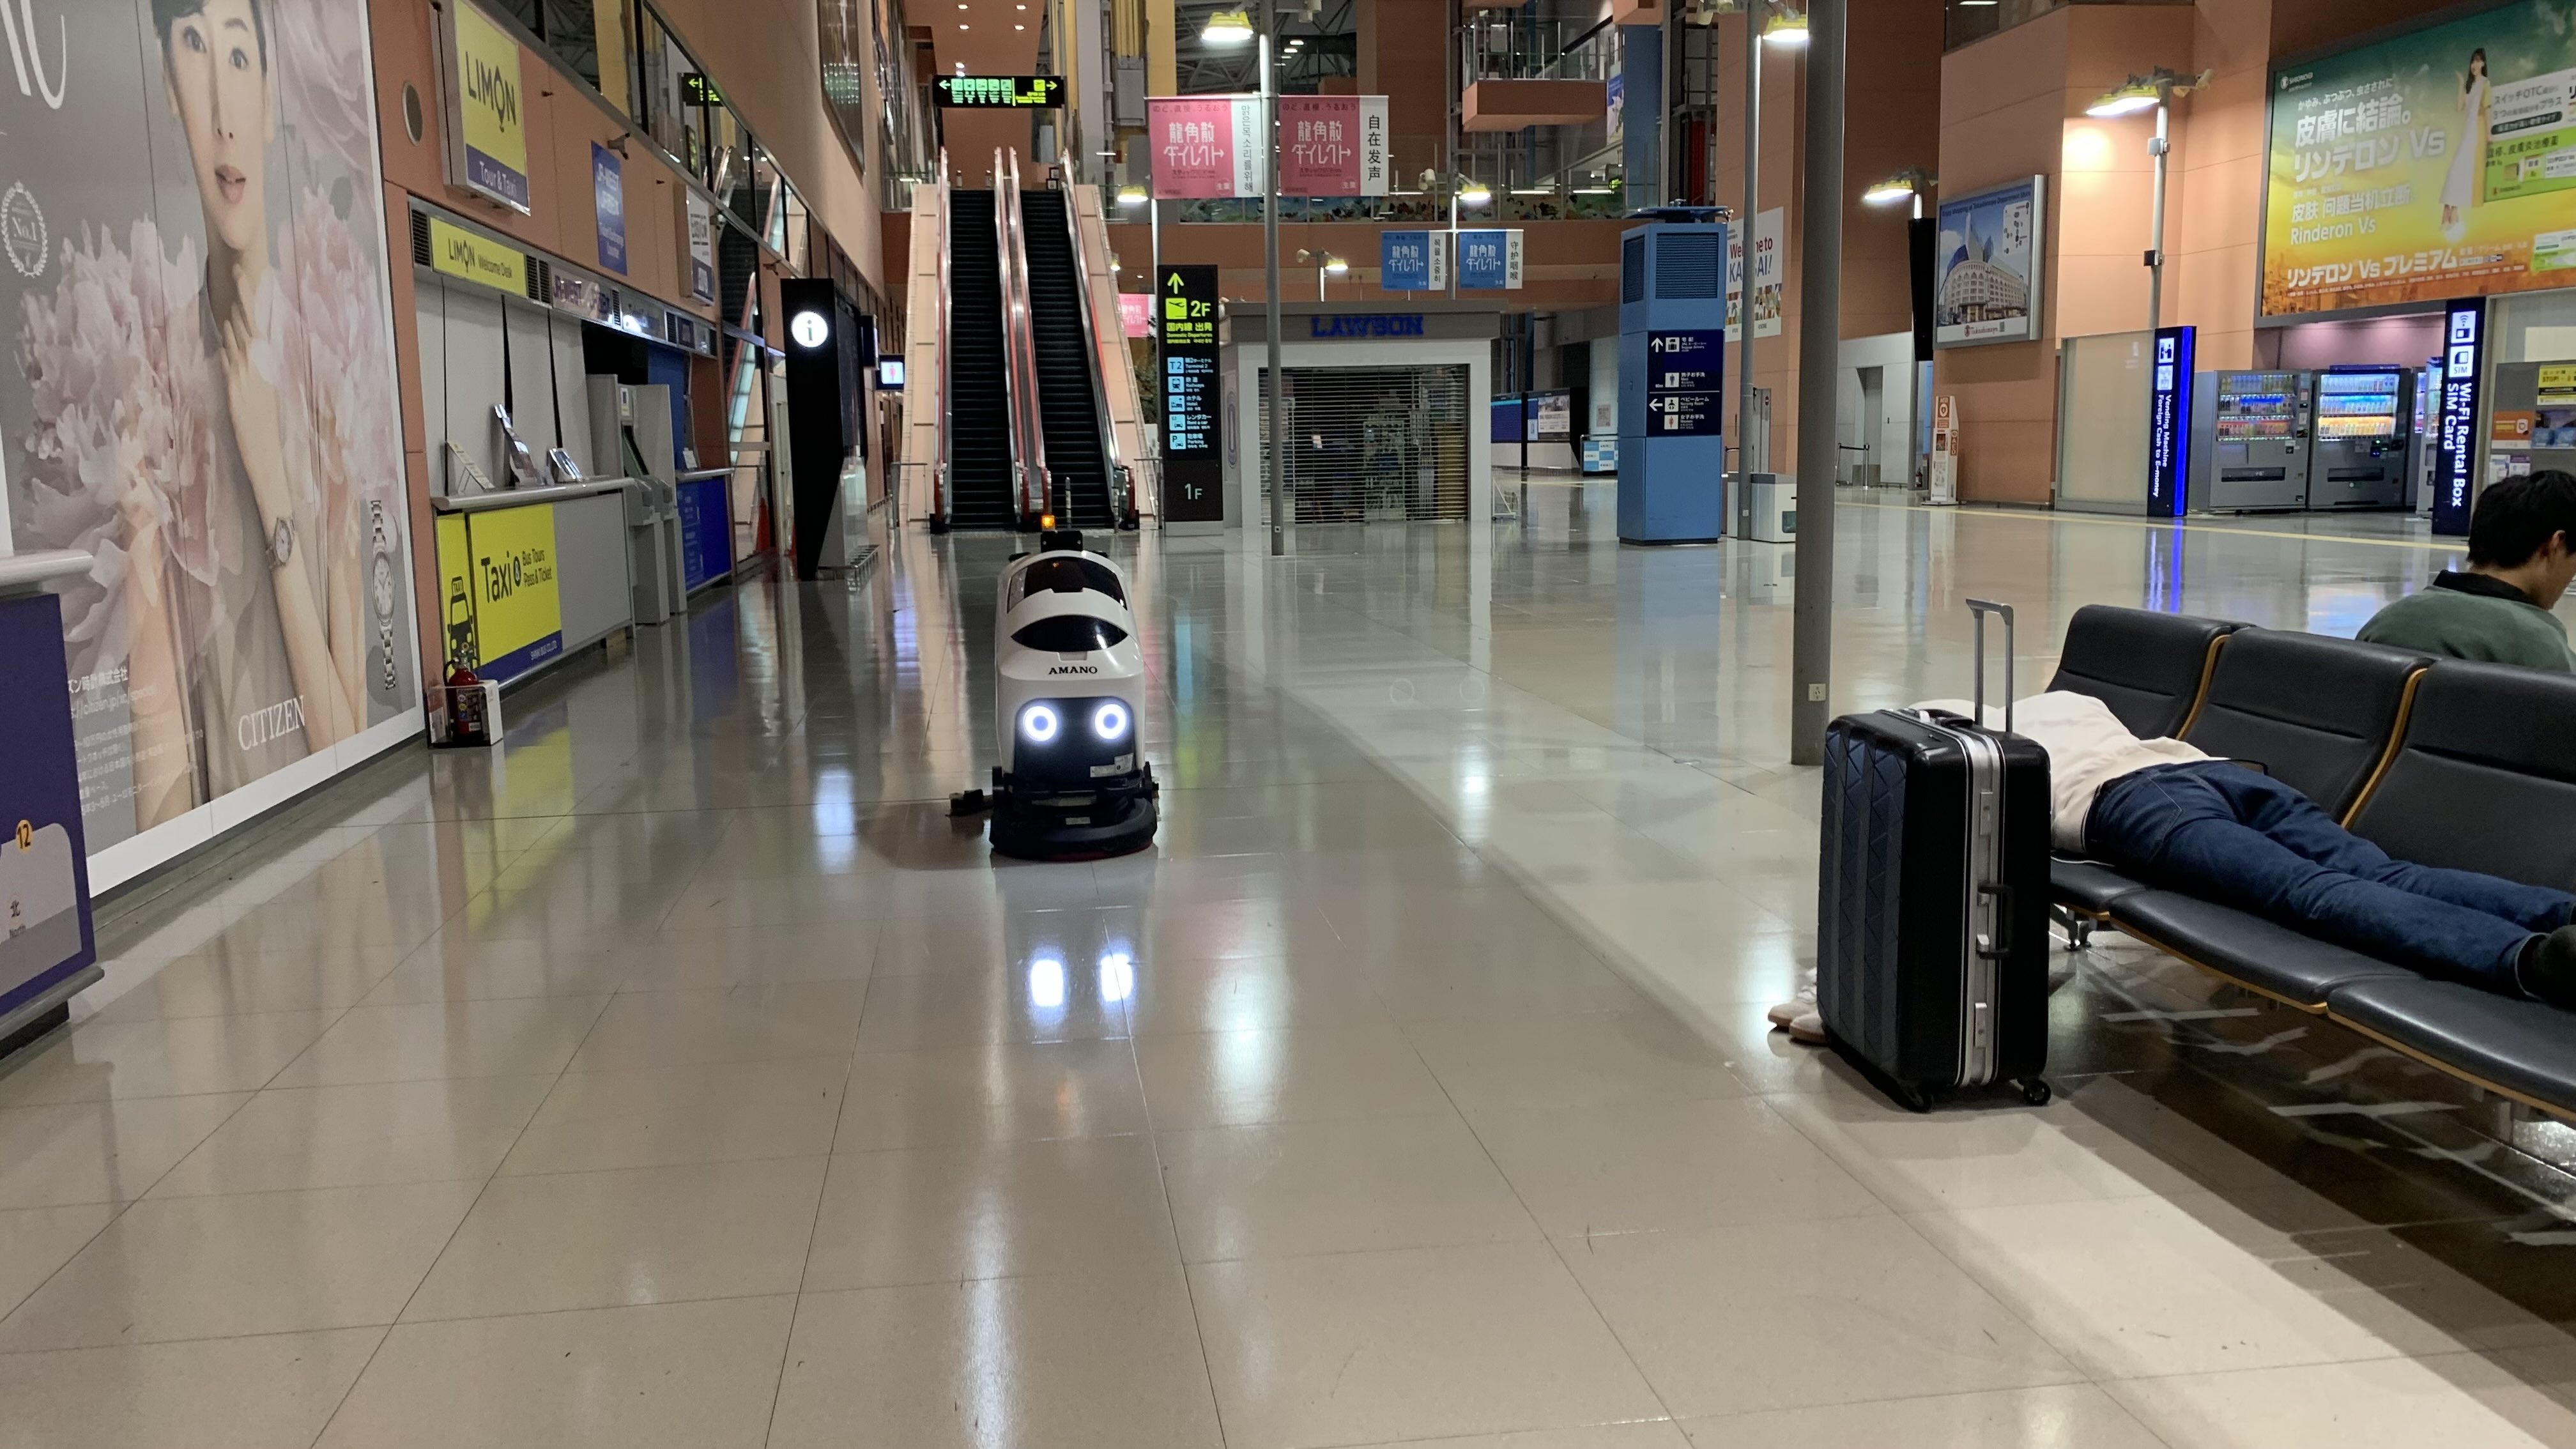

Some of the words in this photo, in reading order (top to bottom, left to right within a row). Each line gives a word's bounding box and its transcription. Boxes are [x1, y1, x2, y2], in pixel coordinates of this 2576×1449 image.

[464, 51, 516, 133] LIMON
[1169, 121, 1215, 144] 龍角散
[1298, 120, 1342, 142] 龍角散
[2296, 93, 2411, 148] 皮膚に結論。
[1367, 115, 1381, 181] 自在发声
[2295, 136, 2400, 183] リンデロン
[2409, 126, 2446, 158] Vs
[479, 160, 496, 187] Tour
[12, 216, 37, 241] No.1
[2290, 222, 2353, 245] Rinderon
[2358, 215, 2376, 234] Vs
[448, 238, 475, 273] LIMON
[1765, 236, 1773, 252] to
[1729, 254, 1772, 283] KAAI!
[2287, 259, 2354, 288] リンデロン
[2358, 258, 2380, 279] Vs
[2383, 248, 2458, 276] プレミアム
[1190, 300, 1211, 317] 2F
[1312, 316, 1423, 337] LAWSON
[1169, 361, 1182, 370] T2
[2453, 366, 2468, 374] SIM
[2156, 394, 2165, 426] Foreign
[2446, 383, 2459, 410] SIM
[2458, 383, 2472, 420] Wi-Fi
[2164, 394, 2172, 429] Vending
[2444, 415, 2457, 450] Card
[2156, 448, 2161, 458] to
[2162, 431, 2170, 468] Machine
[2455, 425, 2469, 473] Rental
[1184, 483, 1202, 500] 1F
[2152, 459, 2162, 498] E-money
[2452, 478, 2465, 507] Box
[523, 551, 532, 567] Bus
[532, 548, 545, 565] Tours
[480, 551, 513, 604] Taxi
[1048, 666, 1098, 675] AMANO
[238, 695, 305, 750] CITIZEN
[17, 824, 31, 849] 12
[10, 900, 20, 917] 北
